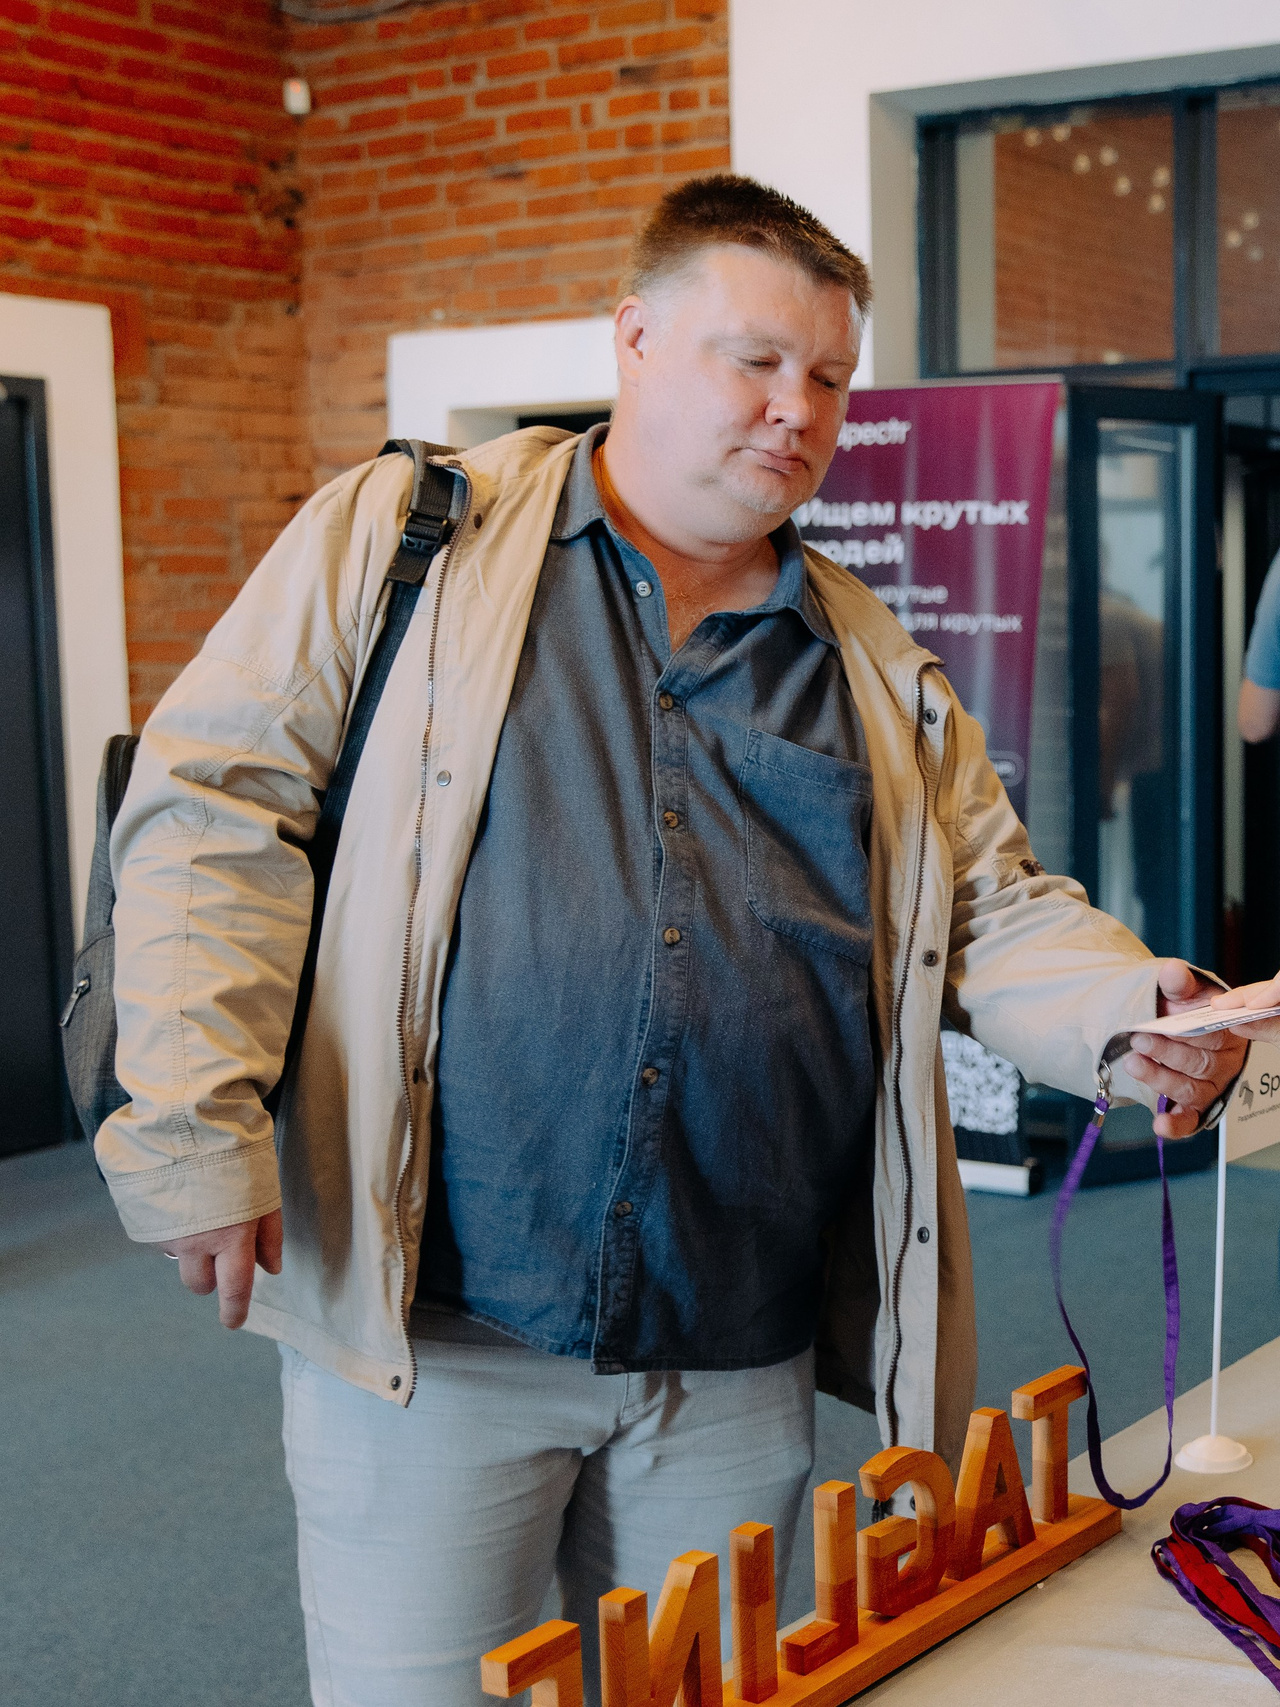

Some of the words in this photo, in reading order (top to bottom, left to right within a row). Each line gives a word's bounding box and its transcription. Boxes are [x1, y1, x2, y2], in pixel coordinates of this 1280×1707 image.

[798, 498, 896, 530] Ищем
[901, 500, 1030, 530] крутых
[940, 612, 1023, 635] крутых
